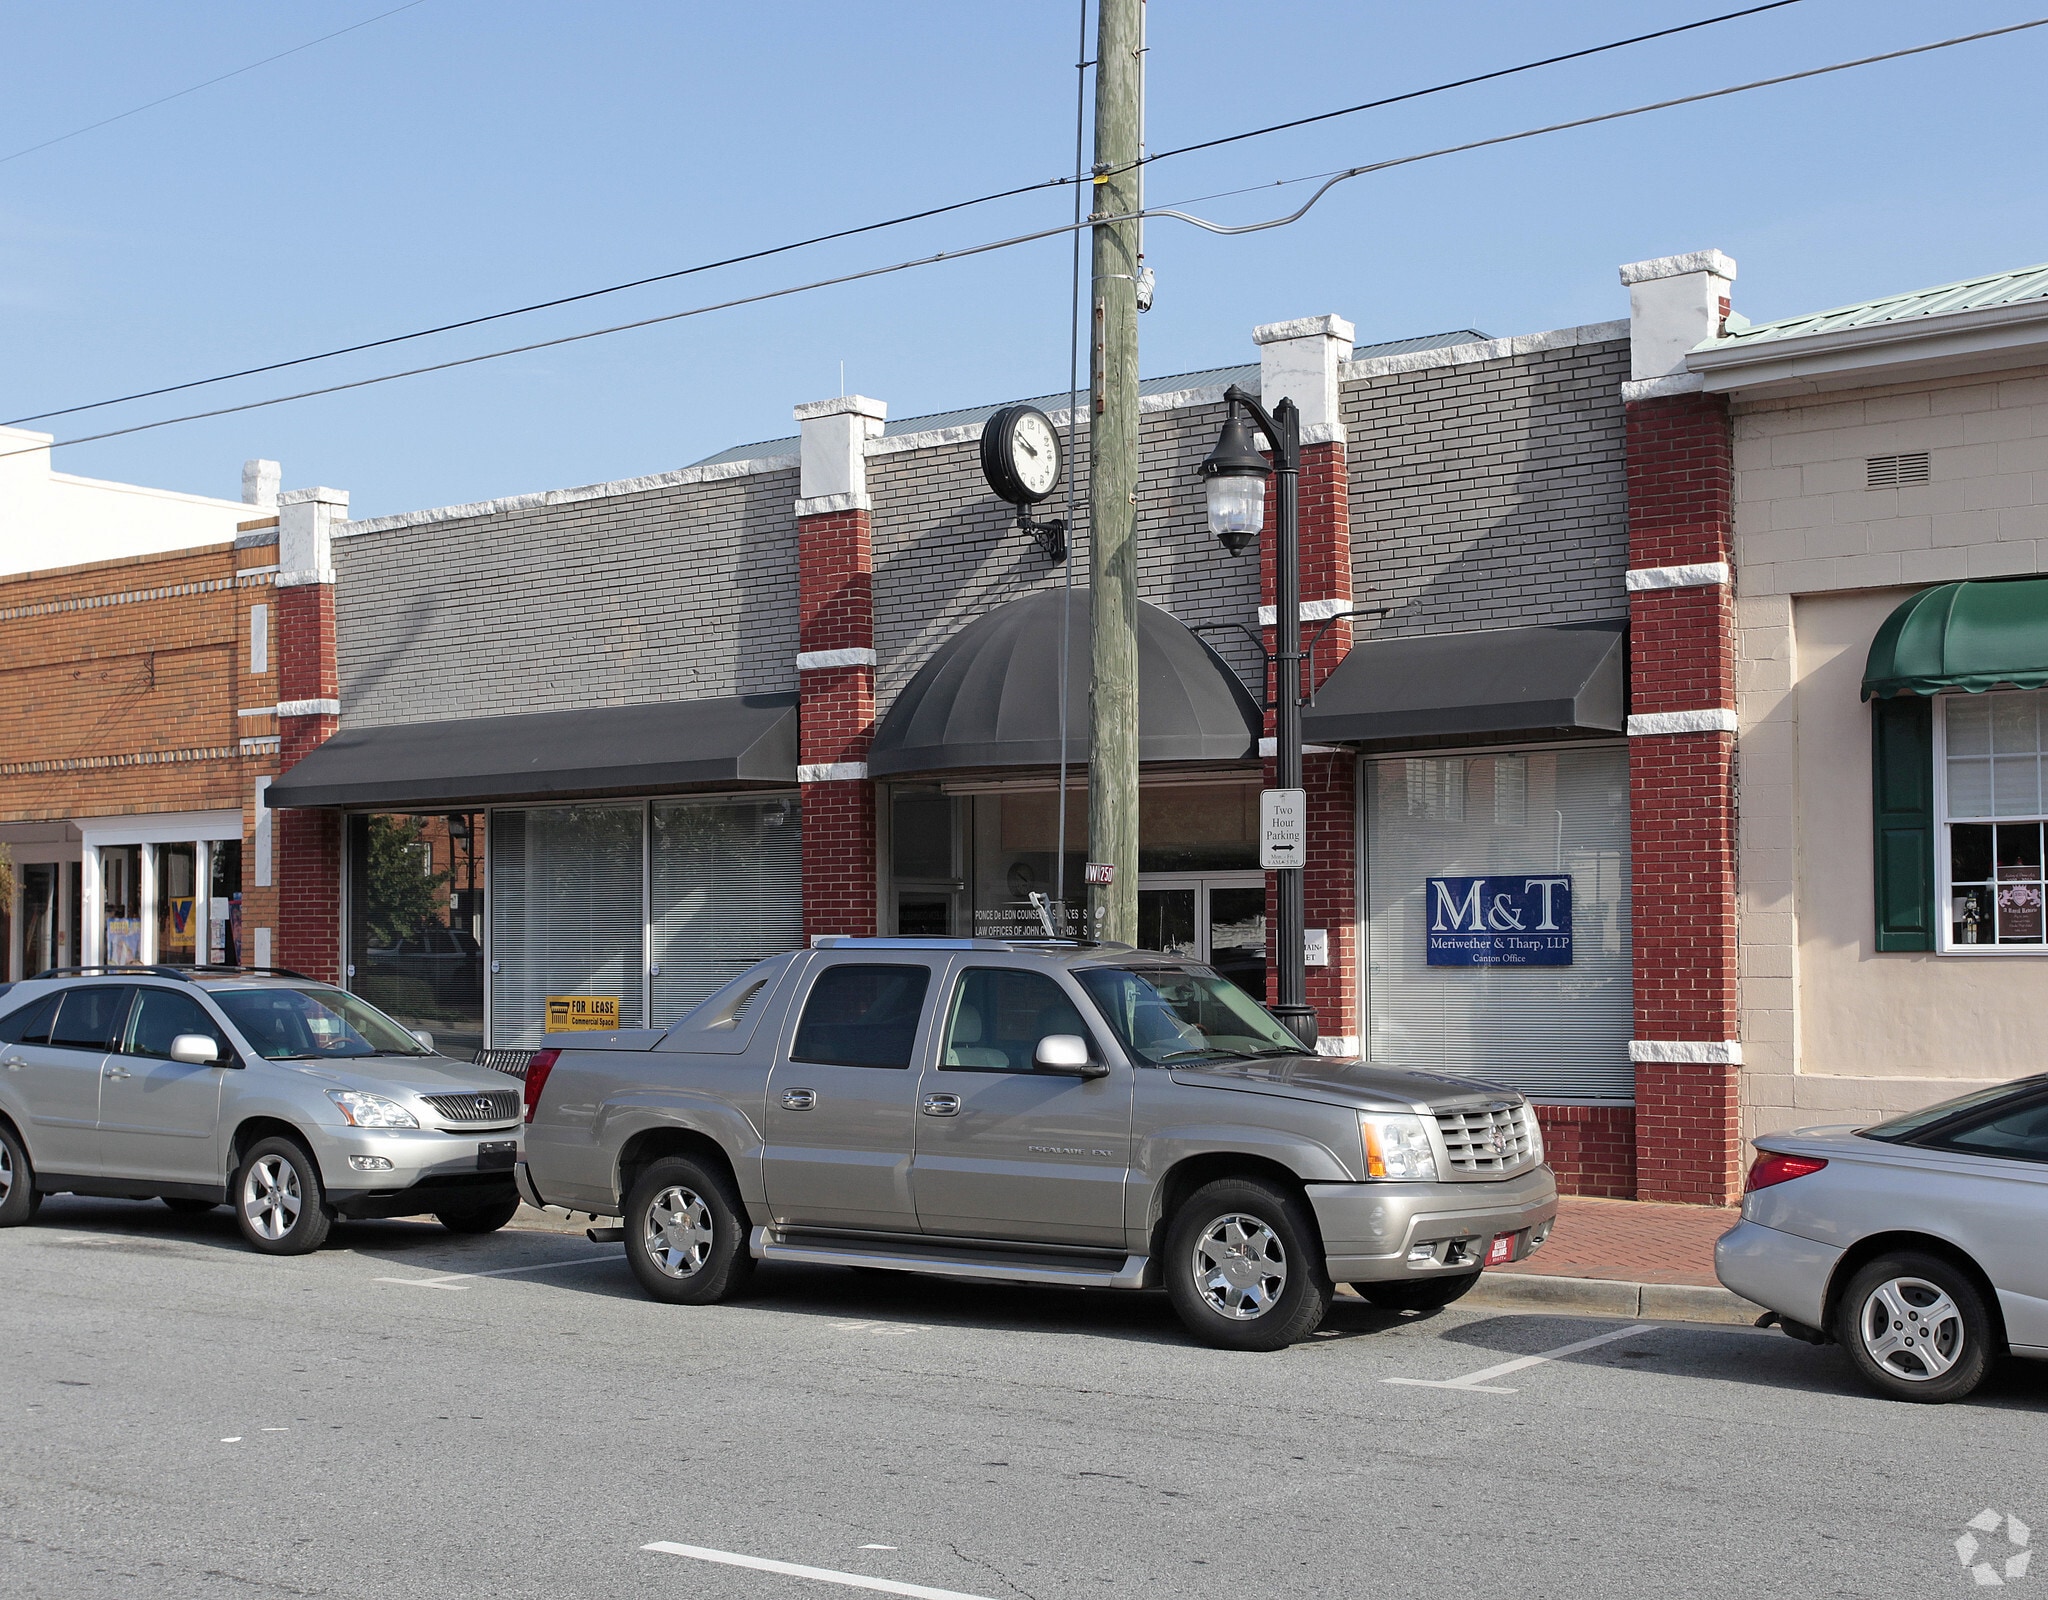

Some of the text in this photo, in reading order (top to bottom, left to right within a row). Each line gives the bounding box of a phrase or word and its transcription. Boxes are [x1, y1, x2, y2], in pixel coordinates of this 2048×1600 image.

[1273, 805, 1293, 815] Two
[1272, 818, 1294, 828] Hour
[1266, 830, 1300, 842] Parking
[1100, 866, 1113, 882] 250
[1431, 879, 1569, 931] M&T
[975, 910, 993, 920] PONCE
[1002, 909, 1016, 920] LEON
[975, 926, 988, 936] LAW
[989, 926, 1013, 936] OFFICES
[1014, 926, 1022, 936] OF
[1023, 925, 1039, 936] JOHN
[1431, 937, 1570, 951] Meriwether & Tharp, LLP
[1472, 953, 1526, 962] Canton Office
[572, 1000, 614, 1014] FOR LEASE
[572, 1016, 614, 1027] Commercial Space
[1028, 1145, 1085, 1155] ESCALADE
